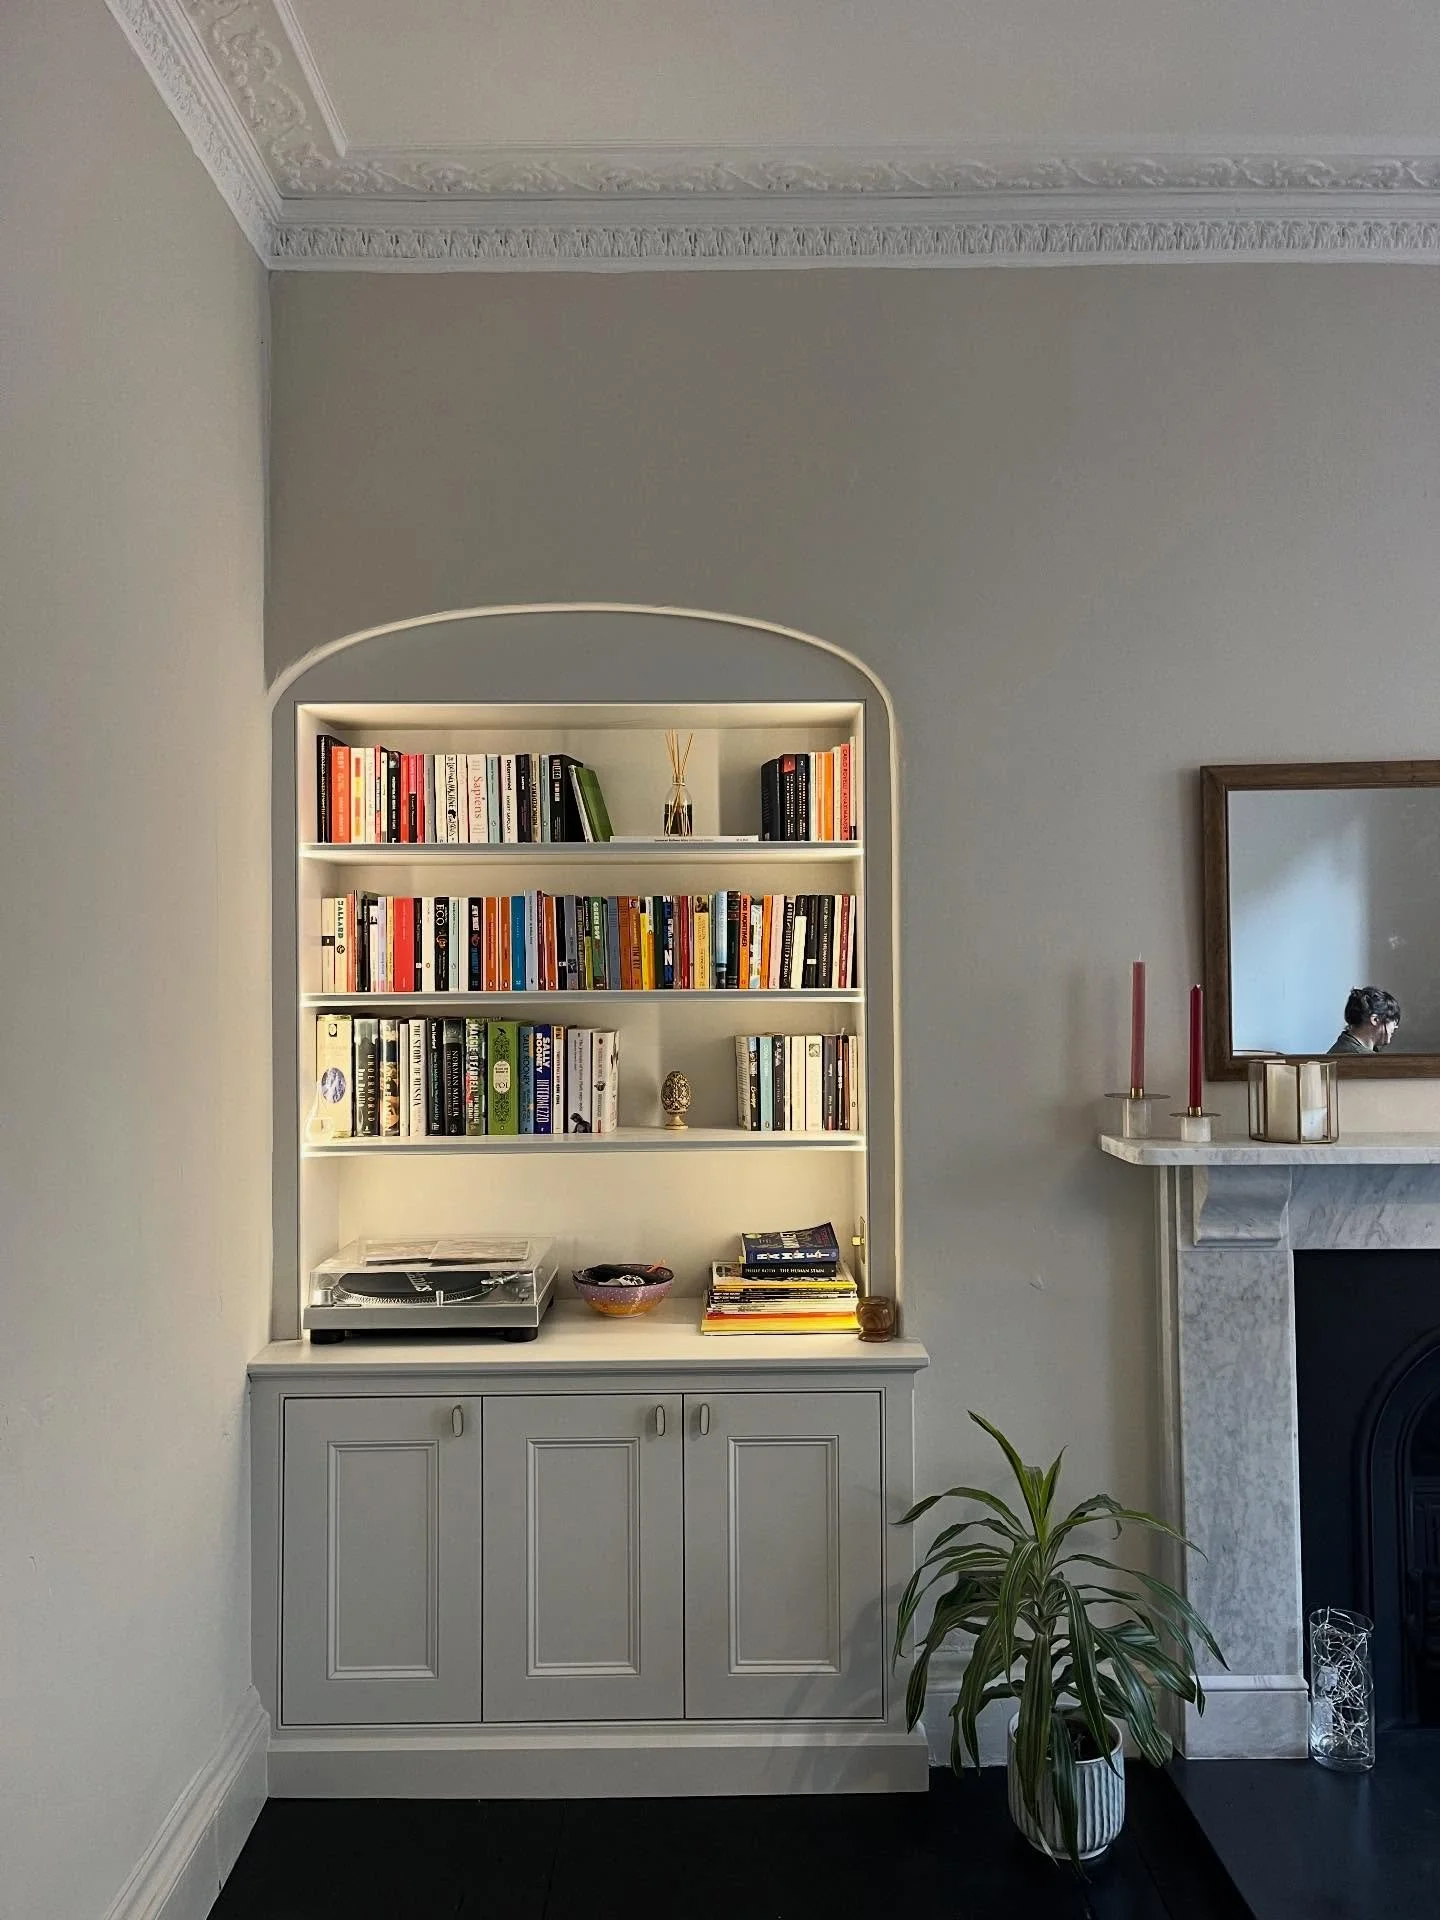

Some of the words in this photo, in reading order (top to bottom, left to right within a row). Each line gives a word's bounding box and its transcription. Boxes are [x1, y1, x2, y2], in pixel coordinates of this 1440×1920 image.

[470, 776, 487, 819] Sapiens
[435, 904, 445, 926] ECO
[632, 946, 640, 957] TIM
[413, 1024, 421, 1037] THE
[469, 1023, 479, 1052] MAGGIE
[522, 1034, 530, 1053] SALLY
[413, 1039, 422, 1065] STORY
[535, 1032, 543, 1074] ROONEY
[543, 1036, 551, 1068] SALLY
[358, 1069, 366, 1081] Don
[413, 1067, 421, 1076] OF
[469, 1055, 479, 1094] O'FARRELL
[522, 1055, 530, 1085] ROONEY
[358, 1083, 366, 1107] DeLillo
[367, 1054, 375, 1122] UNDERWORLD
[413, 1077, 422, 1107] RUSSIA
[536, 1079, 550, 1123] INTERMEZZO
[756, 1251, 830, 1260] HAMNET
